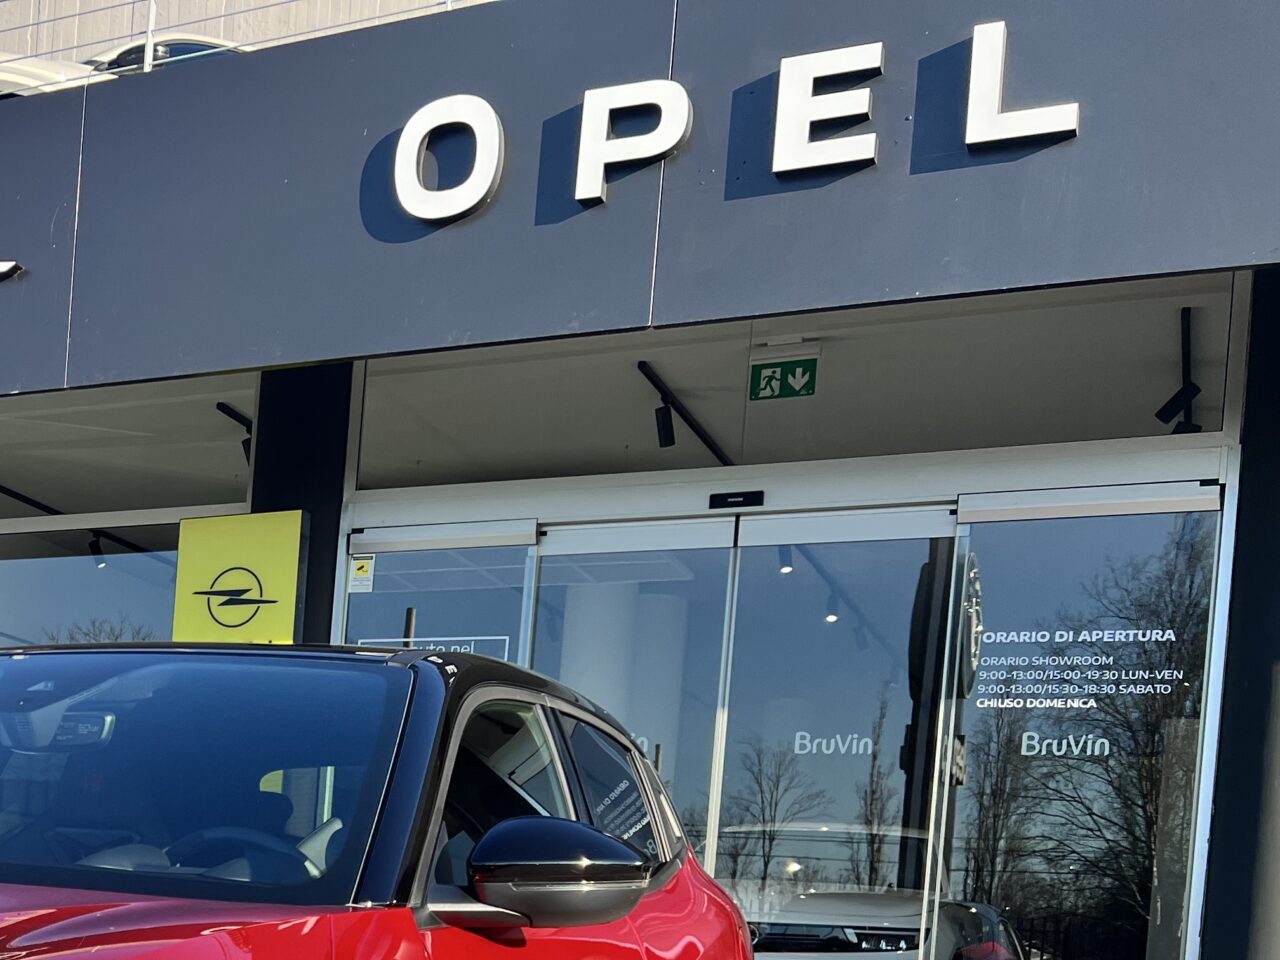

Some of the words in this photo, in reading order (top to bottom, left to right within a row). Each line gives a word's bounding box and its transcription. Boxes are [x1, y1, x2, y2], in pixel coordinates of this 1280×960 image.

[393, 20, 1080, 221] OPEL
[982, 631, 1051, 643] ORARIO
[1054, 630, 1074, 643] DI
[1077, 629, 1176, 642] APERTURA
[980, 656, 1029, 666] ORARIO
[1031, 656, 1114, 666] SHOWROOM
[1121, 669, 1184, 680] LUN-VEN
[1118, 684, 1172, 694] SABATO
[976, 698, 1023, 708] CHIUSO
[1026, 698, 1098, 708] DOMENICA
[794, 731, 873, 755] BruVin
[1020, 732, 1110, 756] BruVin
